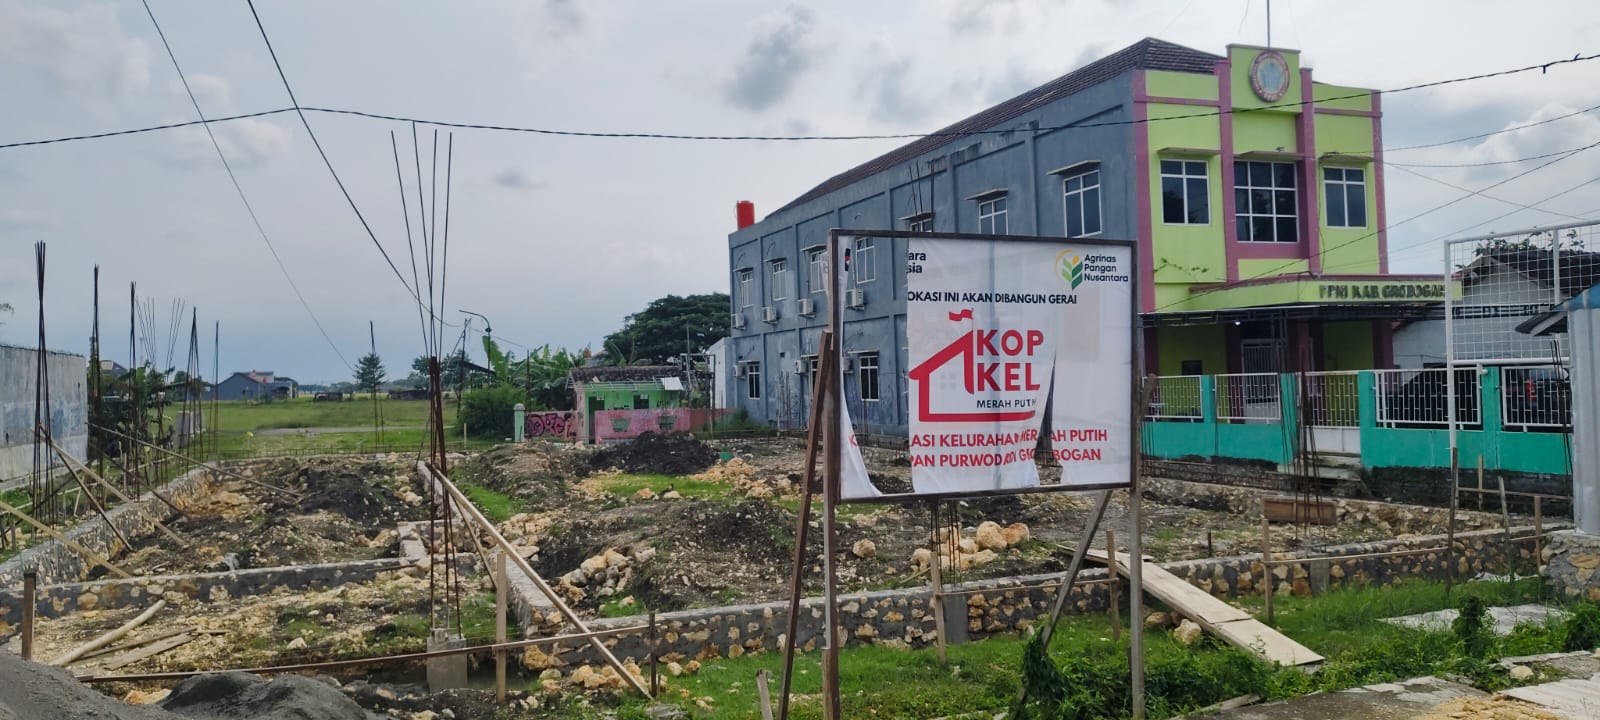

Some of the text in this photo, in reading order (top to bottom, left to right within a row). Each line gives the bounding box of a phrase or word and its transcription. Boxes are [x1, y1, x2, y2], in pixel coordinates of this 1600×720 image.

[1084, 254, 1117, 264] Agrinas
[1084, 264, 1117, 273] Pangan
[1084, 273, 1129, 282] Nusantara
[944, 291, 960, 302] INI
[962, 292, 993, 303] AKAN
[995, 293, 1046, 304] DIBANGUN
[1048, 294, 1077, 304] GERAI
[976, 329, 1044, 357] KOP
[977, 362, 1041, 392] KEL
[976, 399, 1011, 409] MERAH
[1070, 429, 1107, 442] PUTIH
